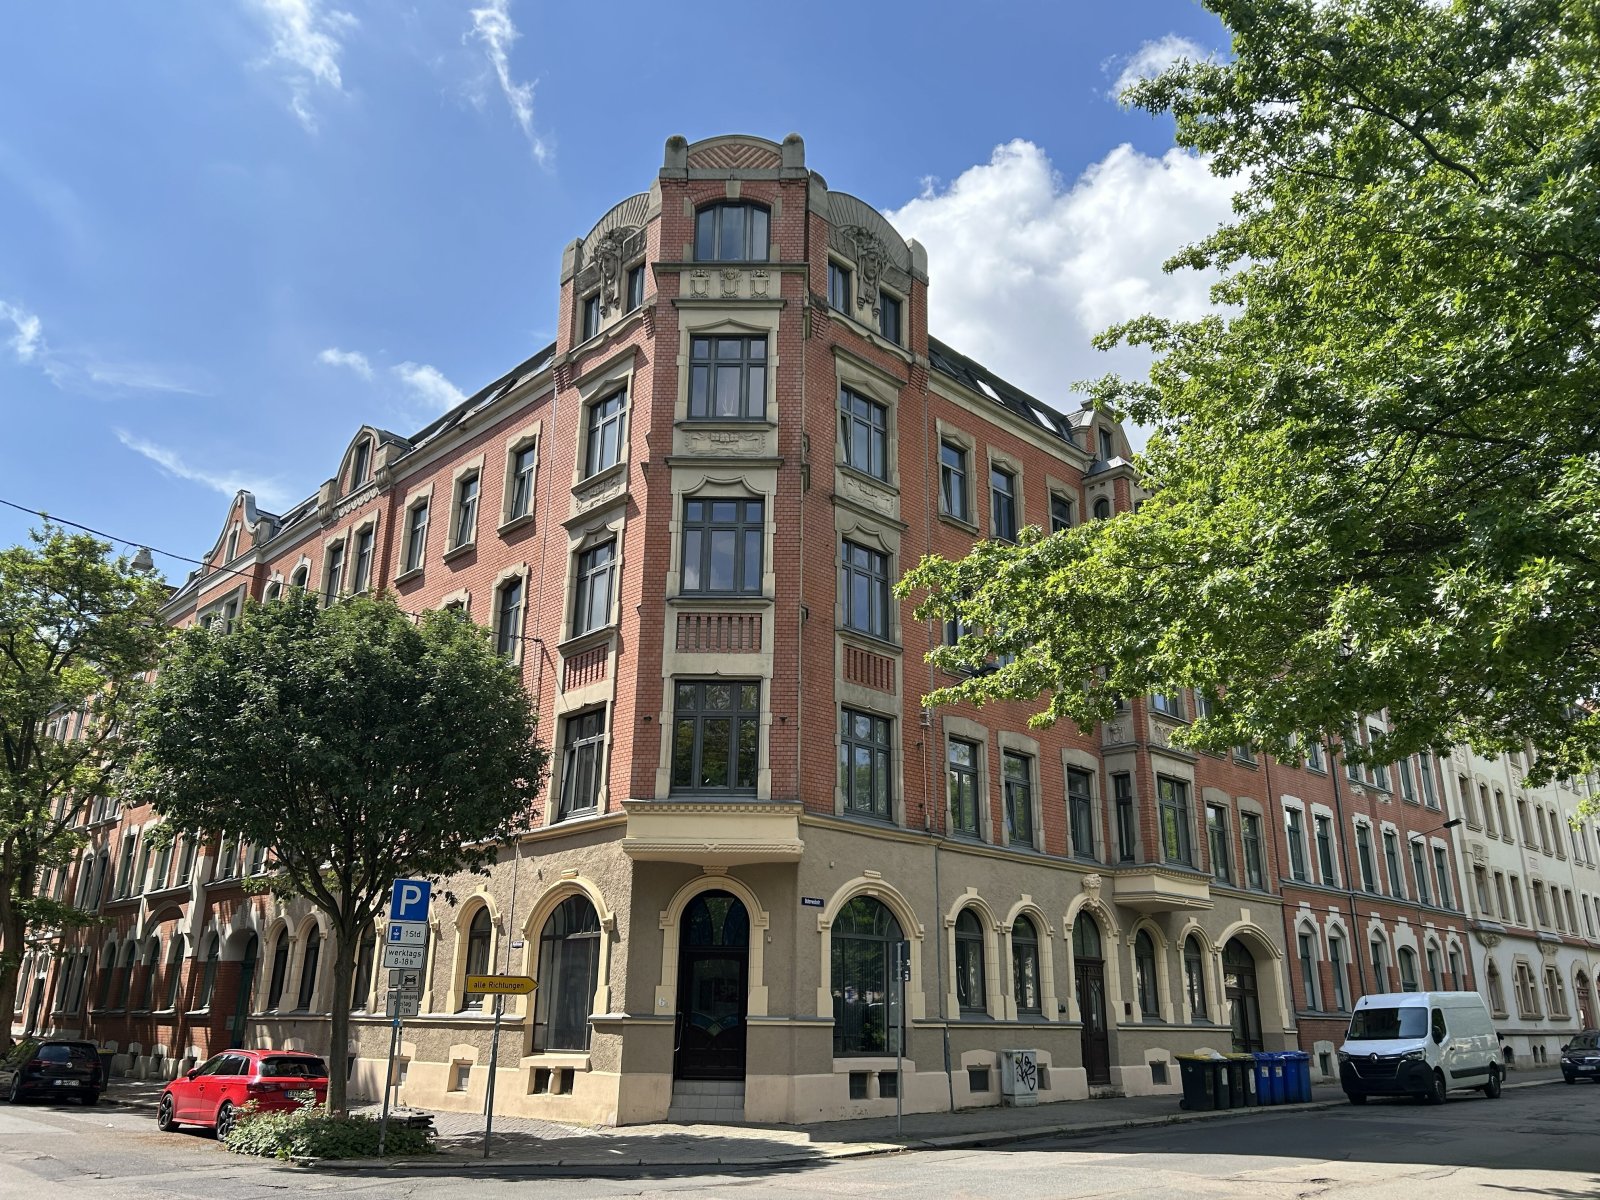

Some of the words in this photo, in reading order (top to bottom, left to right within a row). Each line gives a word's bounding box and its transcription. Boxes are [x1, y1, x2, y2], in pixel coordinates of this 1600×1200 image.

[399, 885, 422, 916] P
[388, 949, 422, 958] werktags
[488, 982, 525, 990] Richtungen
